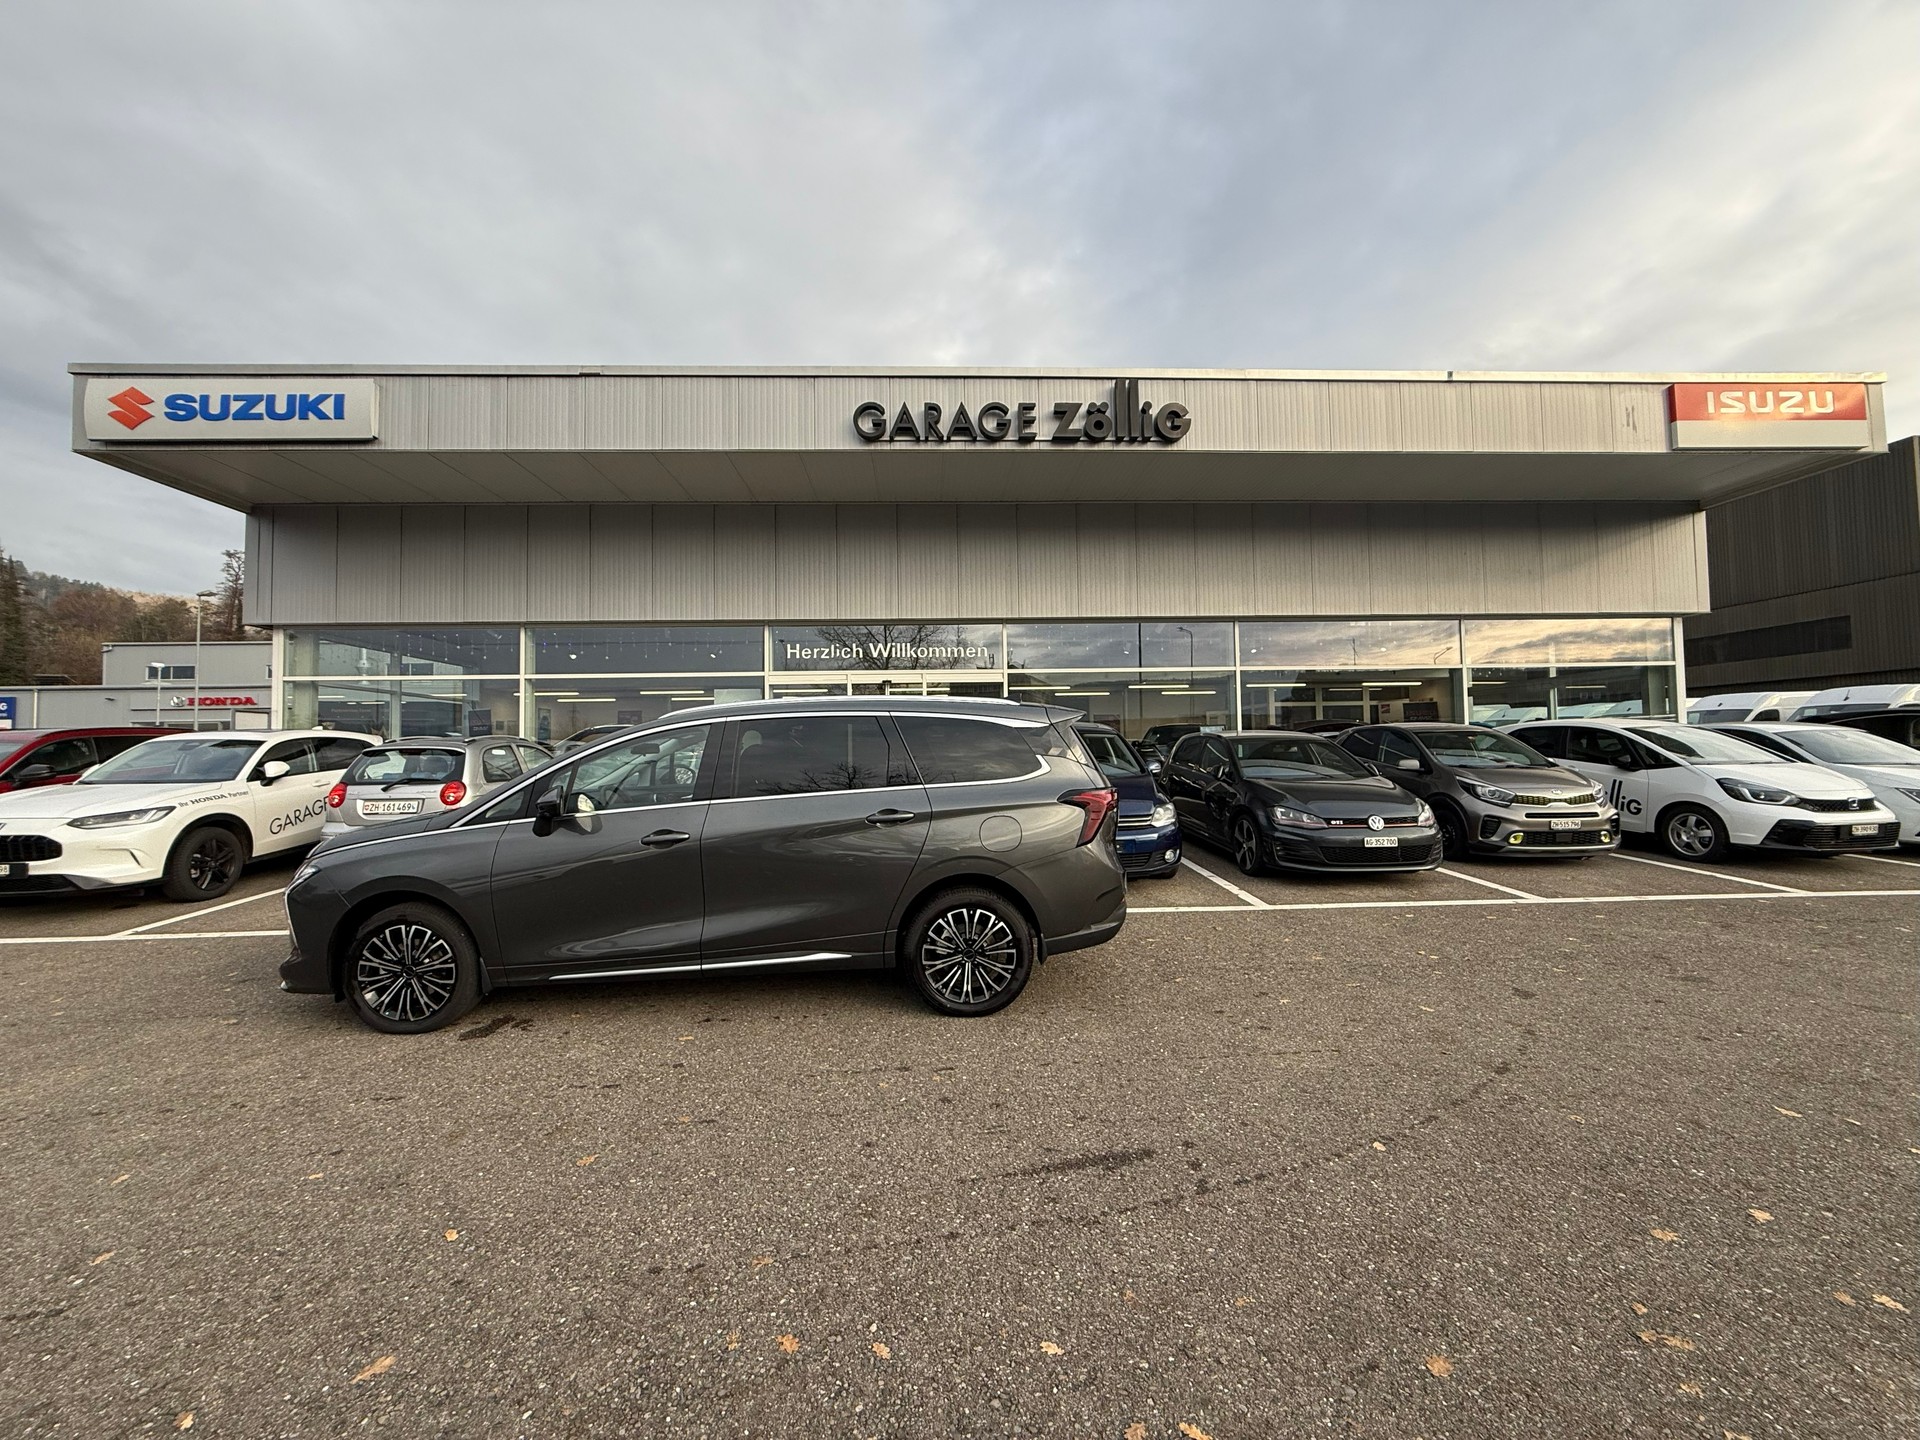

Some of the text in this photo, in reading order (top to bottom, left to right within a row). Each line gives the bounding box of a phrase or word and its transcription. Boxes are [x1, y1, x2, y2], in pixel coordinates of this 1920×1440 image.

[164, 393, 346, 421] SUZUKI
[1706, 391, 1835, 414] ISUZU
[853, 401, 1037, 441] GARAGE
[786, 642, 988, 659] Herzlich Willkommen
[187, 696, 258, 706] HONDA
[189, 794, 228, 805] HONDA
